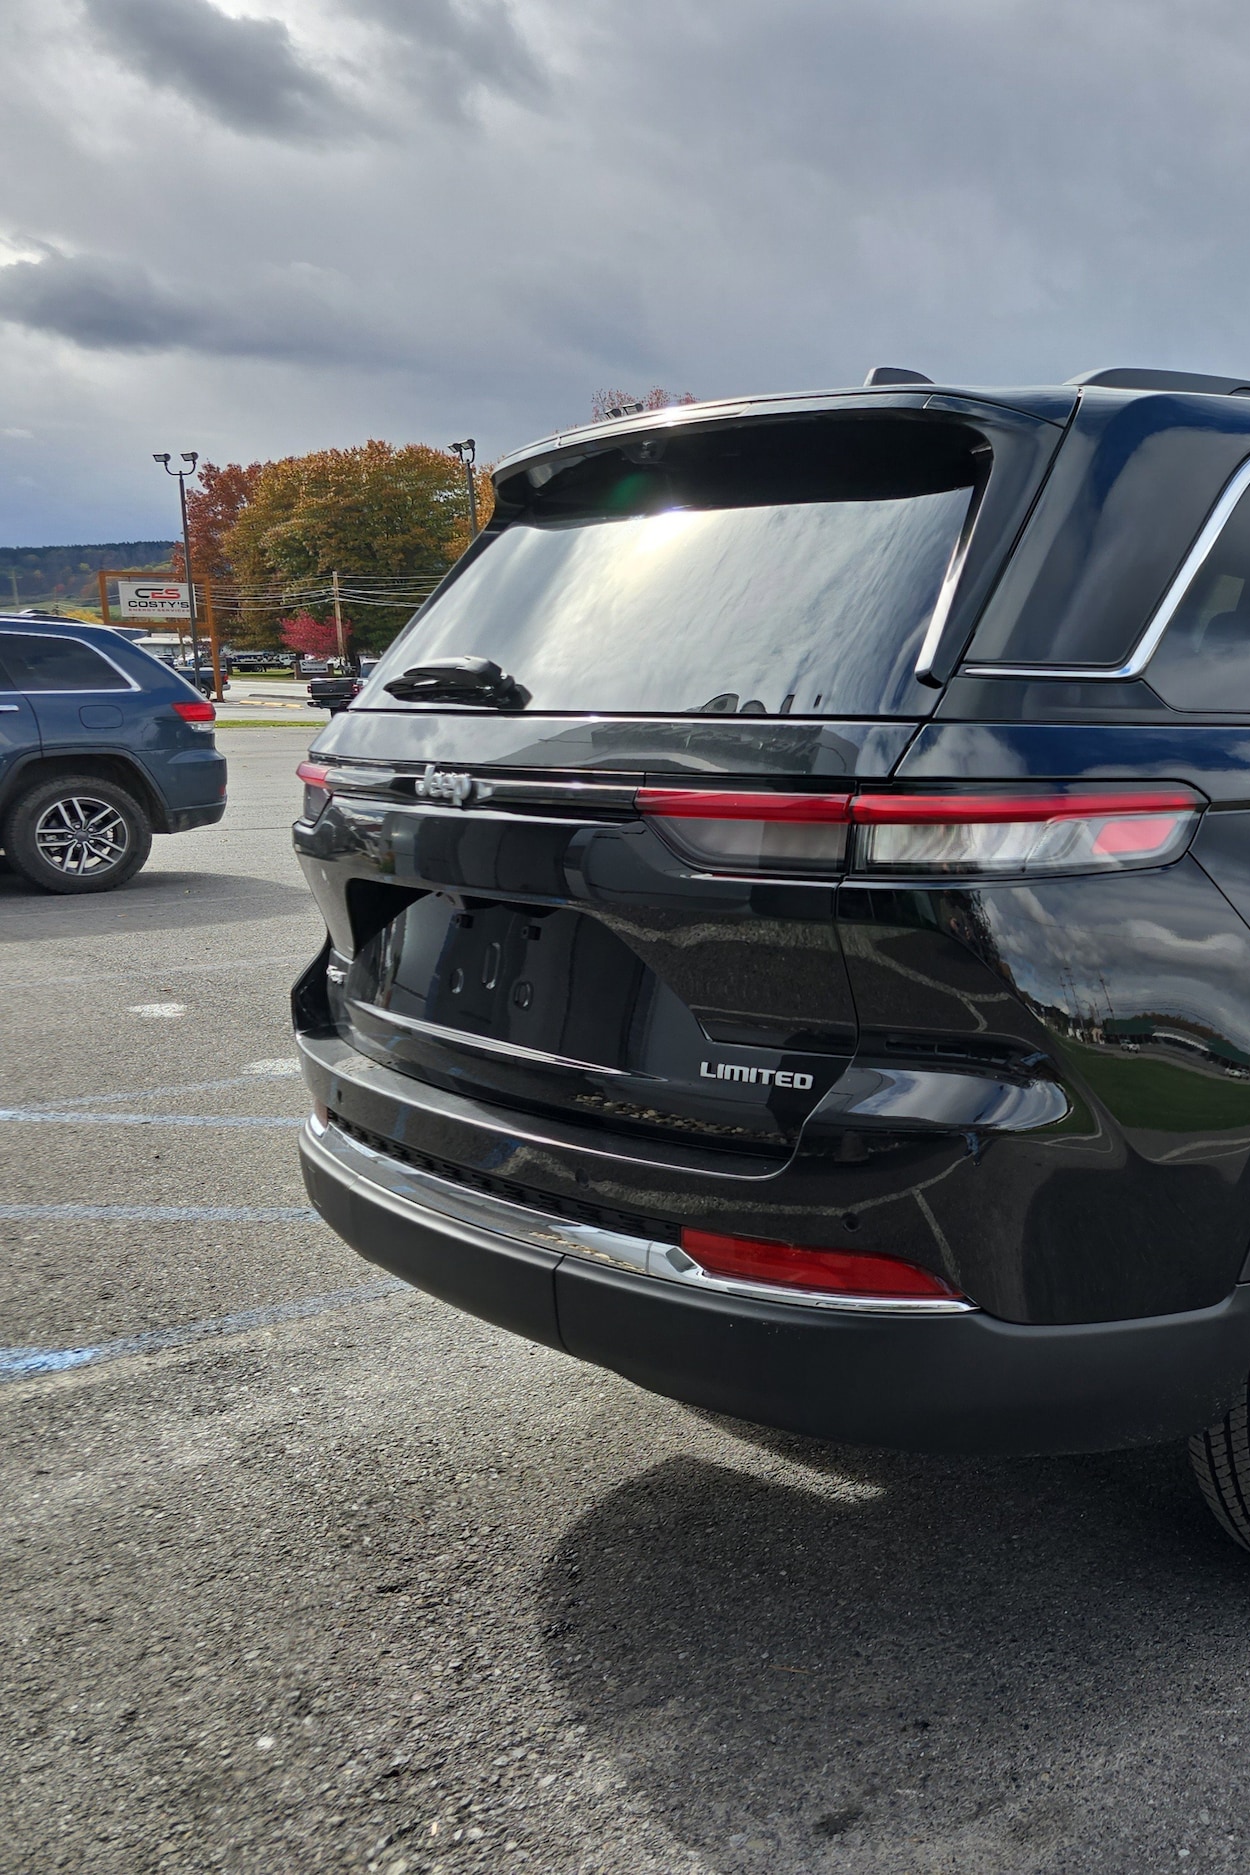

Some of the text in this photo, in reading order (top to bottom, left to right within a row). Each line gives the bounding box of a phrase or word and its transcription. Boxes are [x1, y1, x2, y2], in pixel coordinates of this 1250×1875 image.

[128, 600, 190, 608] COSTY'S
[415, 764, 472, 806] Jeep
[700, 1061, 814, 1090] LIMITED
